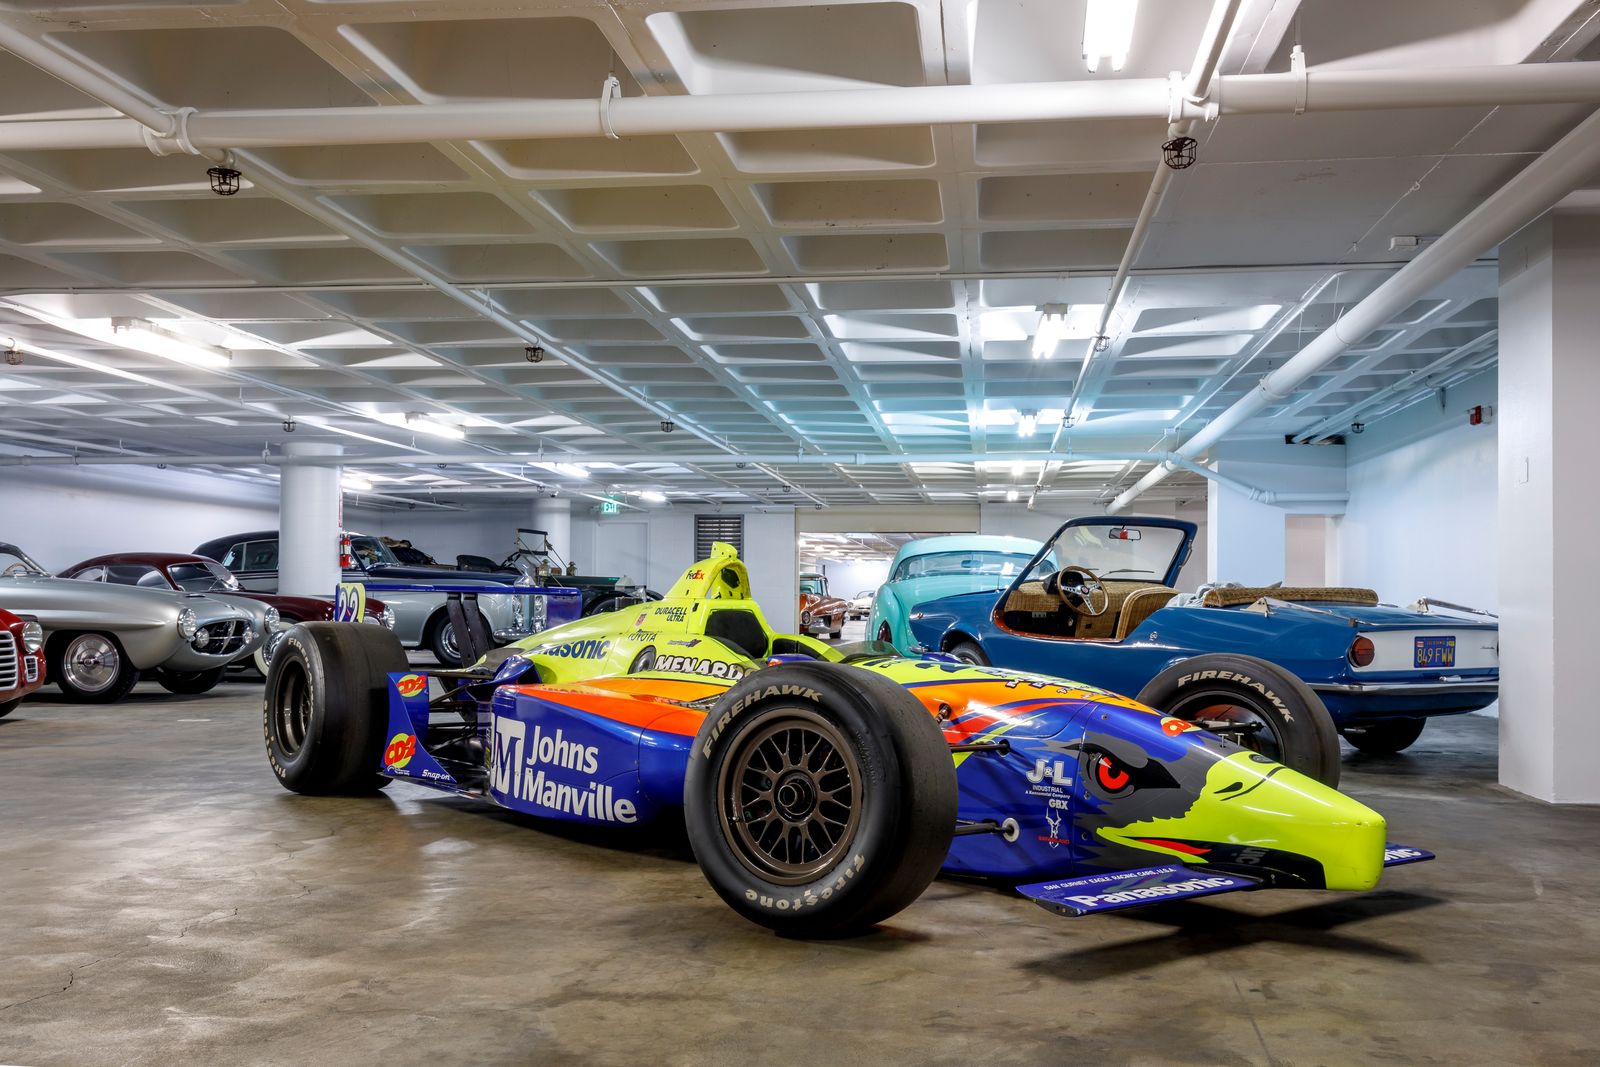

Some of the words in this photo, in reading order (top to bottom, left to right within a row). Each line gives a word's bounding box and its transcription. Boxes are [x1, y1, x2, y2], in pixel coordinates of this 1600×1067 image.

[686, 570, 704, 579] FedEx
[338, 587, 360, 622] 22
[655, 607, 687, 615] DURACELL
[628, 632, 657, 642] TOYOTA
[1417, 648, 1433, 663] 849
[1435, 648, 1454, 663] FWW
[1177, 670, 1295, 723] FIREHAWK
[702, 684, 823, 760] FIREHAWK
[526, 725, 598, 774] Johns
[421, 769, 451, 781] Snap-on
[1026, 758, 1073, 786] J&L
[522, 767, 637, 823] Manville
[1032, 785, 1064, 793] INDUSTRIAL
[1048, 799, 1069, 810] GBX
[745, 853, 865, 911] Firestone
[1089, 876, 1110, 884] EAGLE
[1064, 876, 1234, 908] Panasonic
